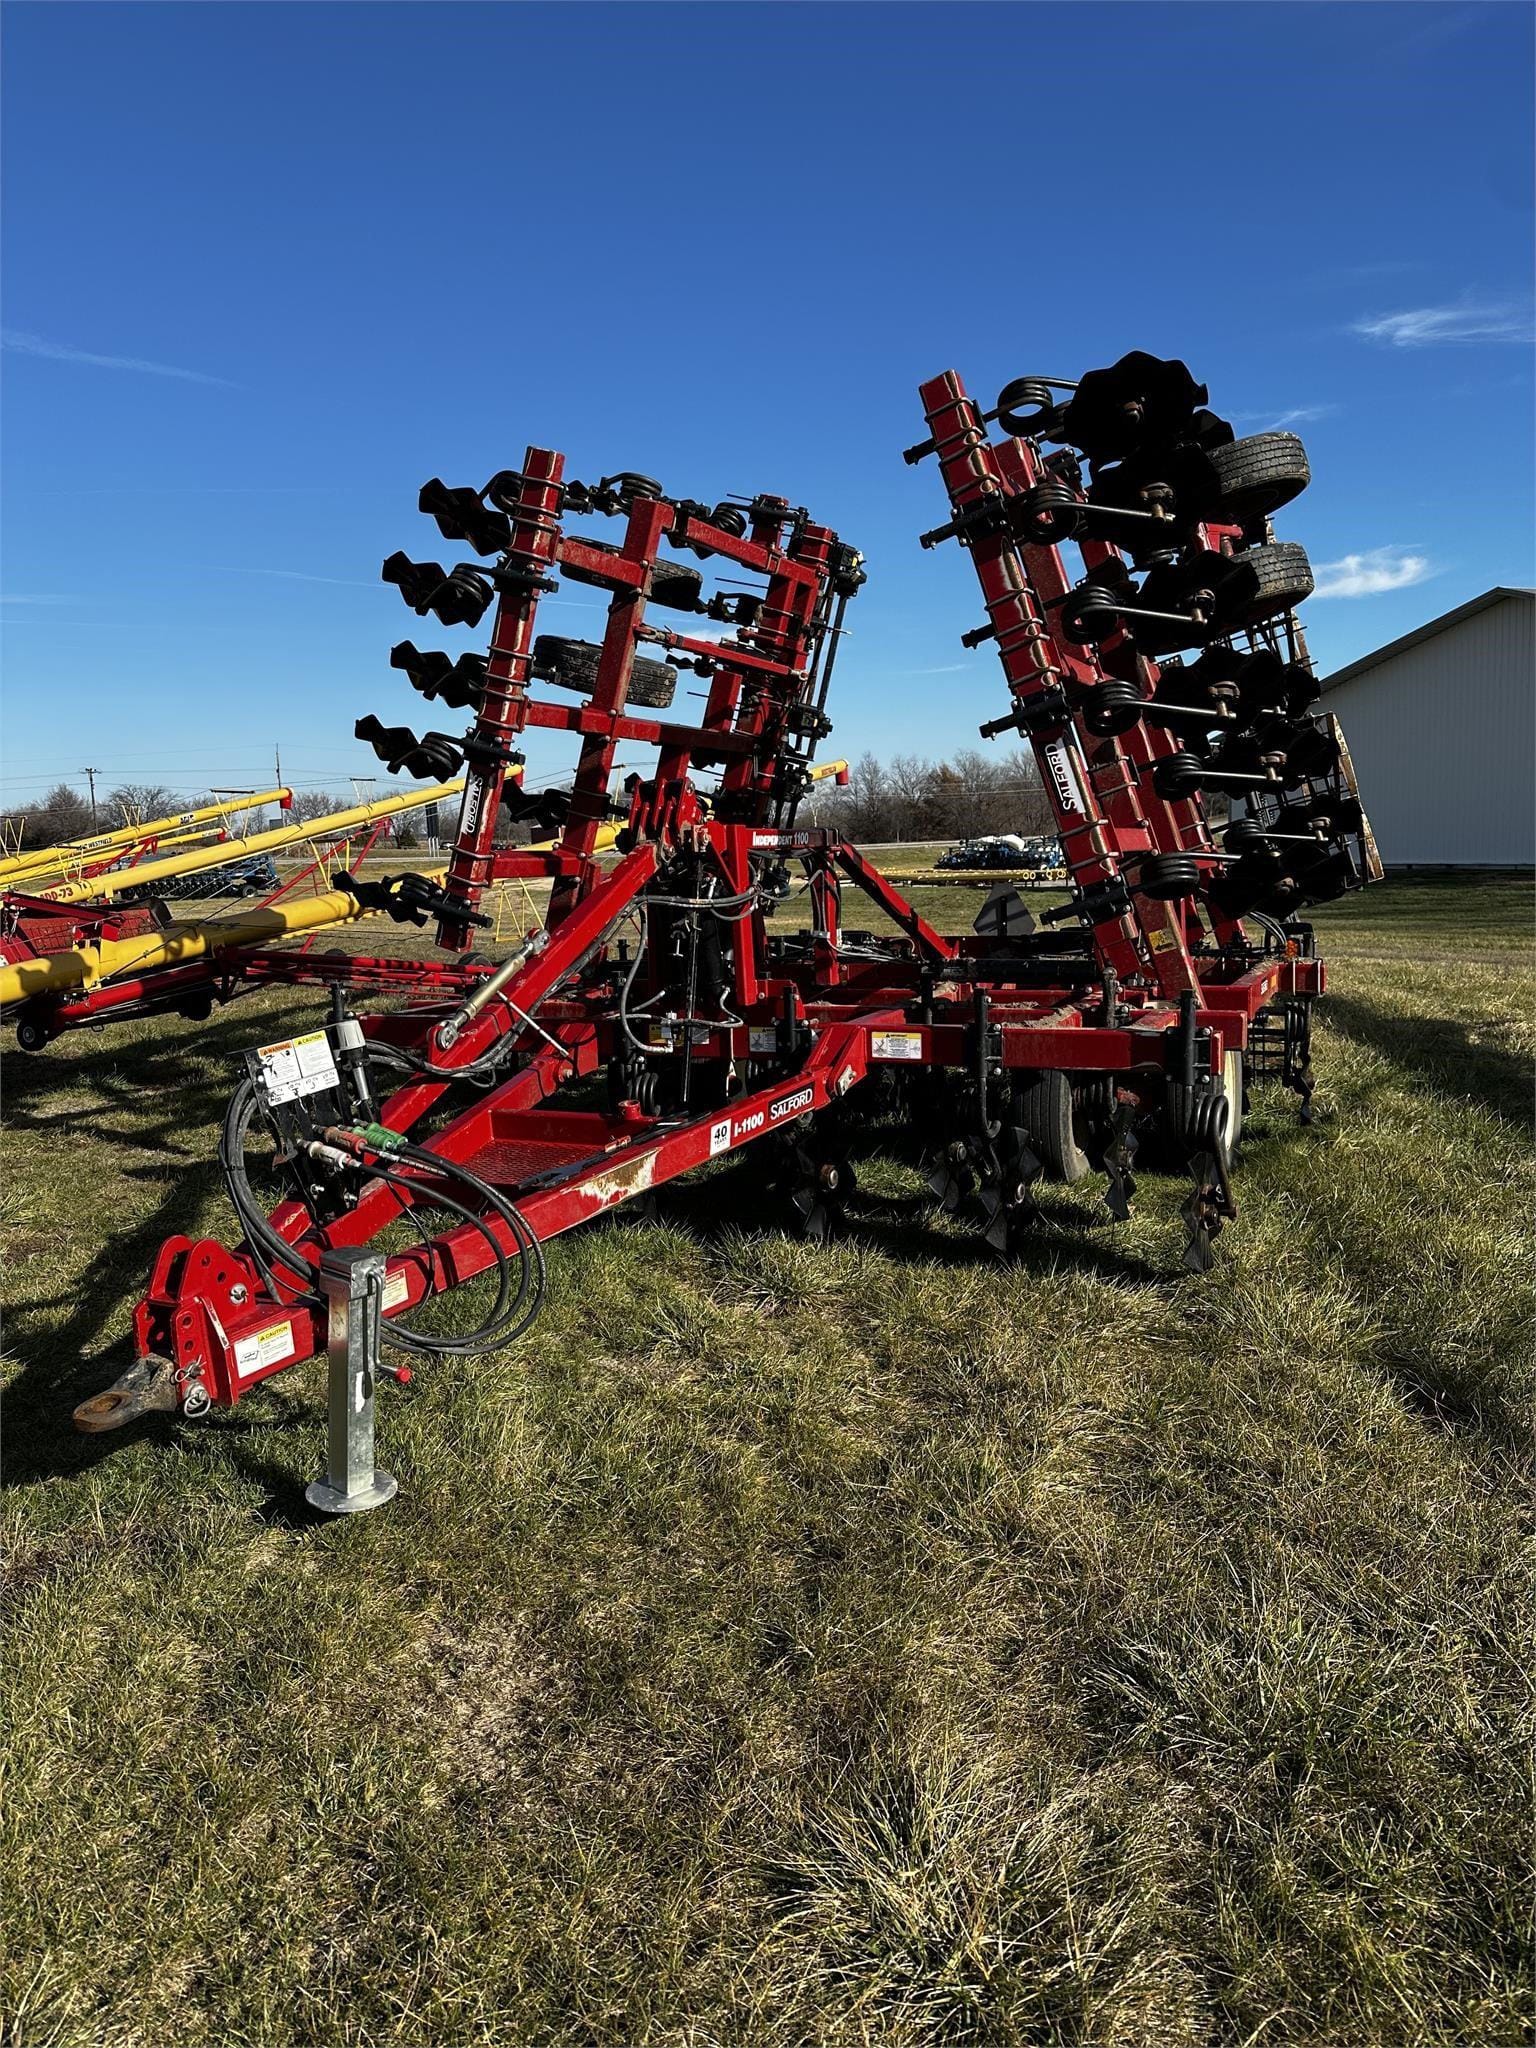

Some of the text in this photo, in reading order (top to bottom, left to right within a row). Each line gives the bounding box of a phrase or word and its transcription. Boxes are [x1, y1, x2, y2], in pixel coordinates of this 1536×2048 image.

[1044, 743, 1077, 810] SALFORD
[465, 774, 483, 834] SALFORD
[752, 831, 809, 847] INDEPENDENT 1100
[302, 1034, 323, 1045] CAUTION
[268, 1042, 291, 1055] WARNING
[770, 1088, 813, 1121] SALFORD
[714, 1125, 728, 1139] 40
[734, 1111, 764, 1137] I-1100
[265, 1326, 288, 1340] CAUTION
